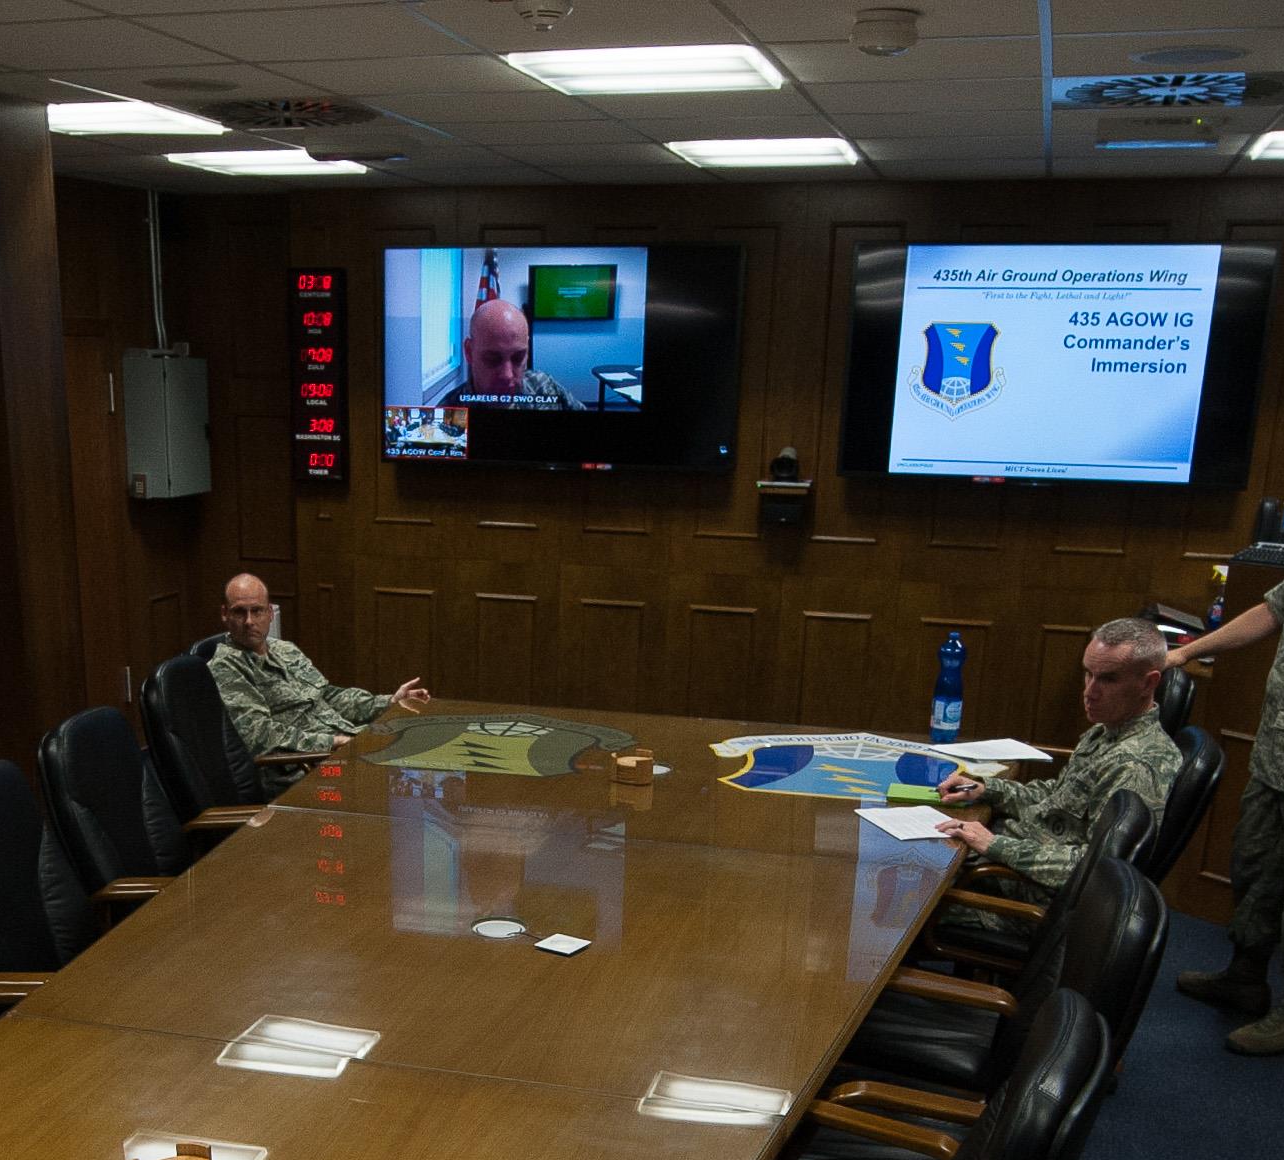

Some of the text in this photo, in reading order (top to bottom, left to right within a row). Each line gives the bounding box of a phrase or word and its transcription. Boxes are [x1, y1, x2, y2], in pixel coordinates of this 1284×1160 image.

[933, 269, 1188, 285] 435th Air Ground Operations Wing
[1006, 292, 1014, 300] to
[1016, 291, 1028, 300] the
[1056, 291, 1083, 300] Lethal
[1084, 292, 1100, 300] and
[1068, 311, 1194, 327] 435 AGOW IG
[1063, 334, 1190, 350] Commander's
[1091, 357, 1187, 374] Immersion
[513, 395, 534, 403] SWO
[535, 395, 558, 403] CLAY
